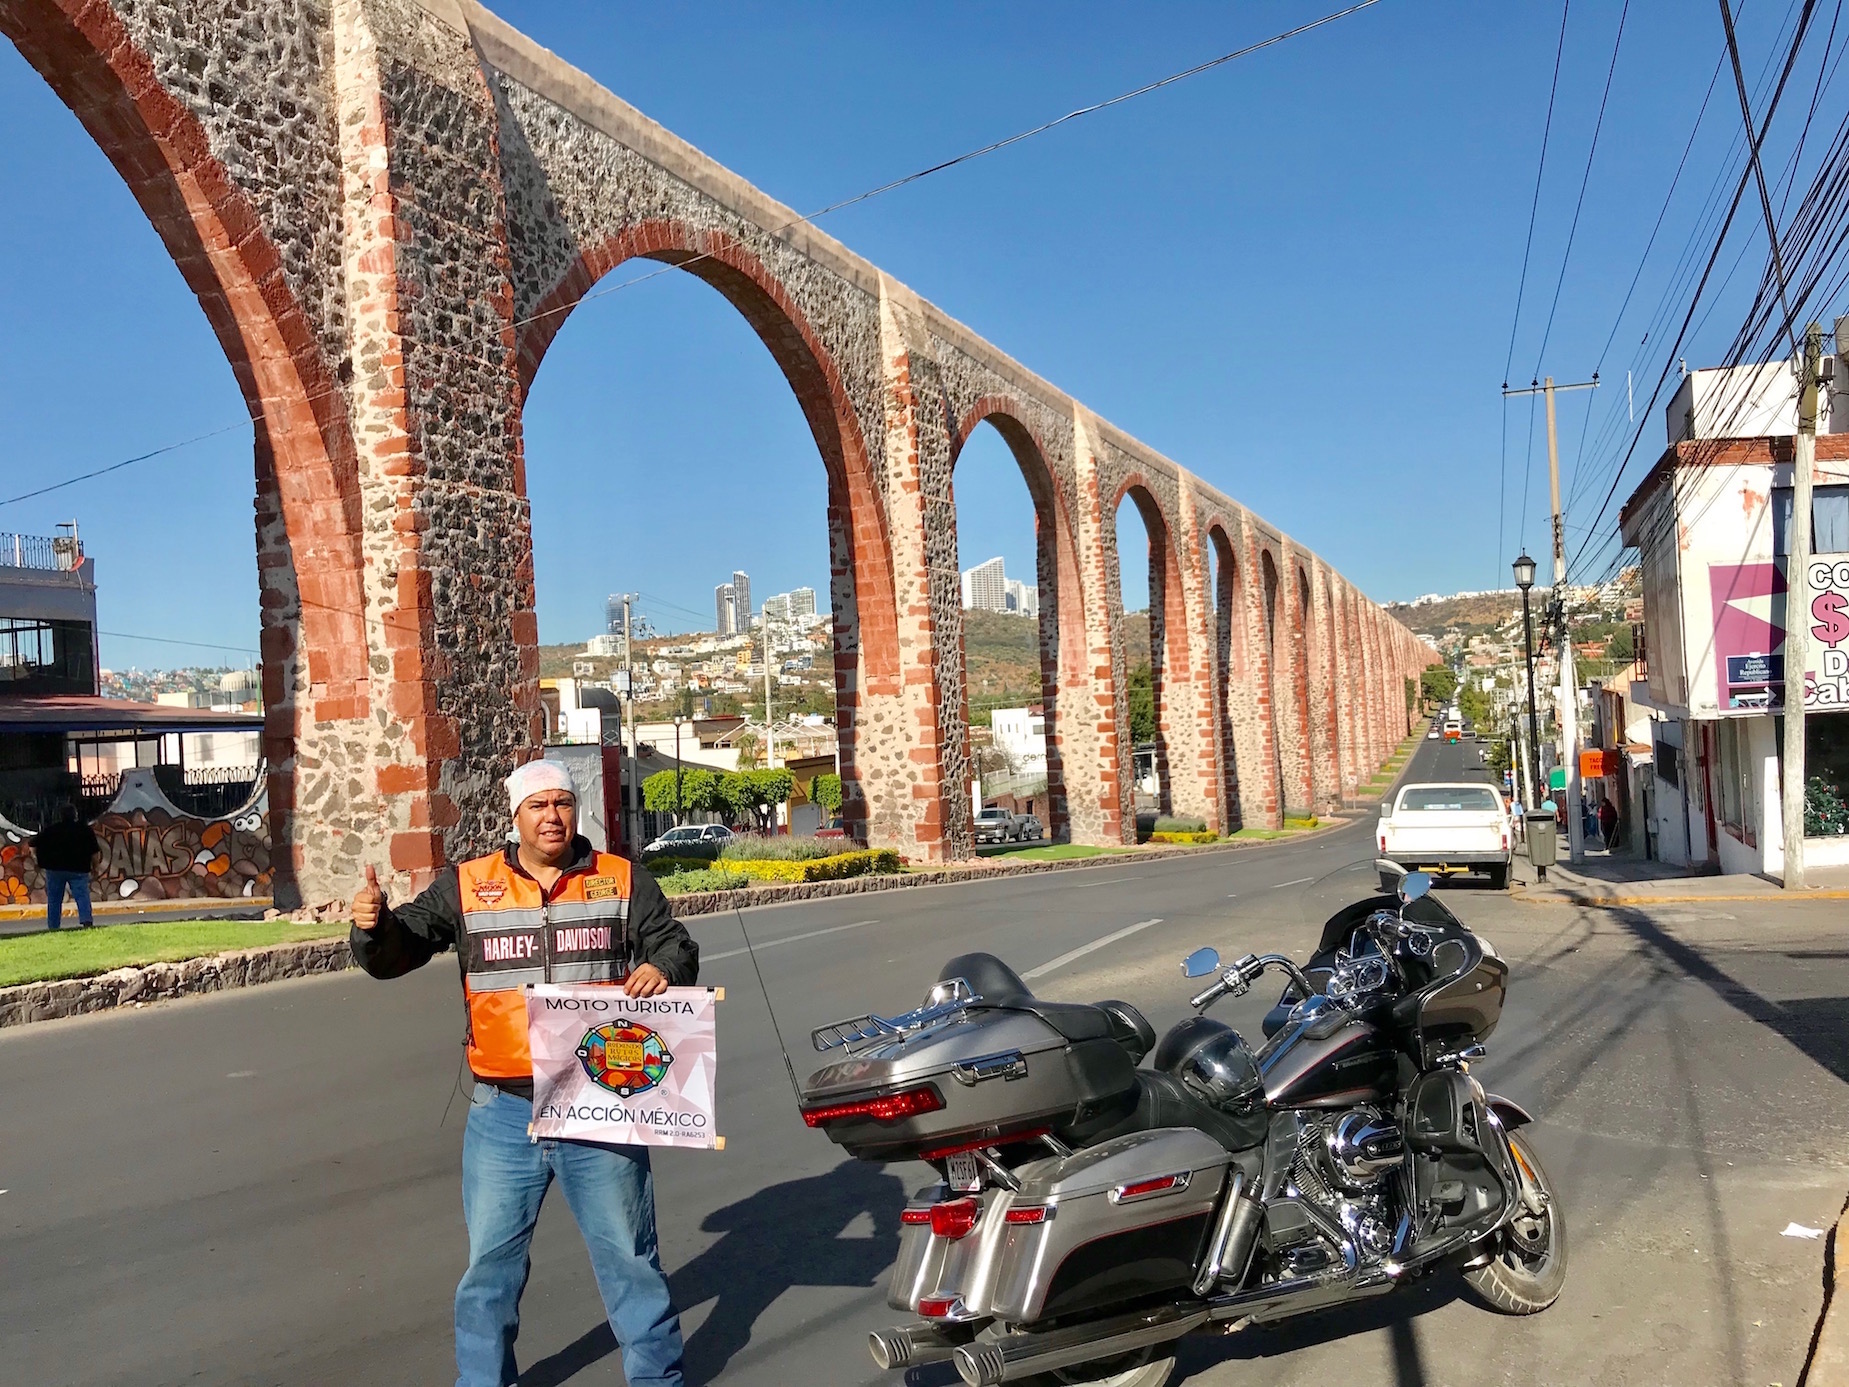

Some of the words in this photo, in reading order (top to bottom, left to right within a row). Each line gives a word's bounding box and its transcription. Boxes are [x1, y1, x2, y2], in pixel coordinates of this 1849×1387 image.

[483, 935, 539, 961] HARLEY-
[556, 926, 612, 952] DAVIDSON
[545, 998, 609, 1011] MOTO
[614, 1000, 694, 1015] TURISTA
[540, 1104, 562, 1119] EN
[566, 1103, 635, 1124] ACCIÓN
[641, 1107, 707, 1128] MÉXICO
